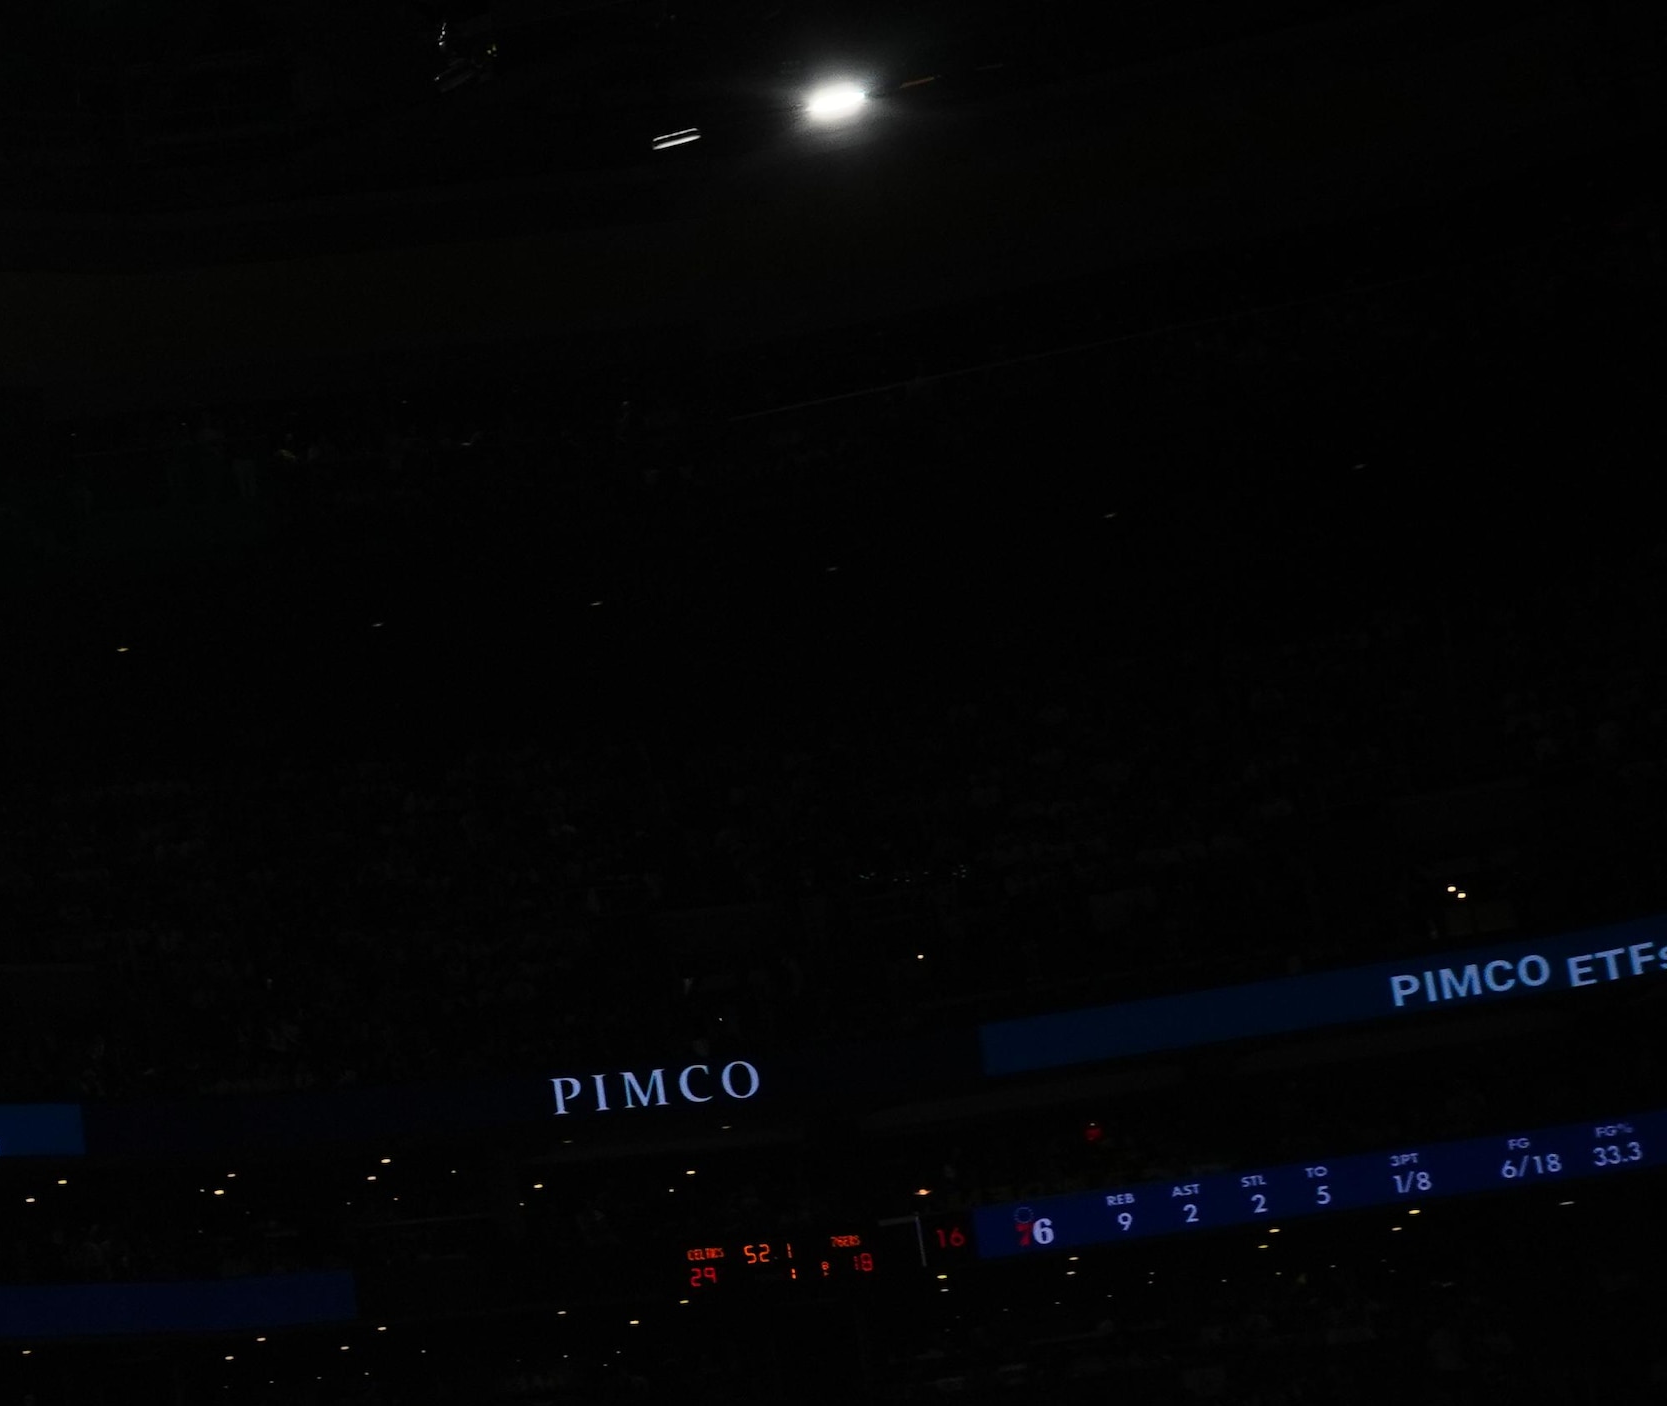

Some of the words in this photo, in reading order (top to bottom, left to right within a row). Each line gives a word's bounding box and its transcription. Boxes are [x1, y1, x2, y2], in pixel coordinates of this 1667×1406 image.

[1389, 954, 1551, 1007] PIMCO
[551, 1060, 760, 1116] PIMCO
[1106, 1192, 1136, 1207] REB
[1171, 1183, 1201, 1198] AST
[1240, 1174, 1267, 1189] STL
[1305, 1166, 1328, 1179] TO
[1390, 1152, 1419, 1167] 3PT
[1508, 1138, 1531, 1151] FG
[1594, 1122, 1634, 1138] FG%
[1116, 1212, 1133, 1232] 9
[1182, 1204, 1200, 1223] 2
[1250, 1194, 1268, 1214] 2
[1315, 1185, 1331, 1205] 5
[1393, 1171, 1433, 1194] 1/8
[1500, 1154, 1563, 1179] 6/18
[1592, 1143, 1643, 1167] 33.3
[1013, 1217, 1055, 1247] 76
